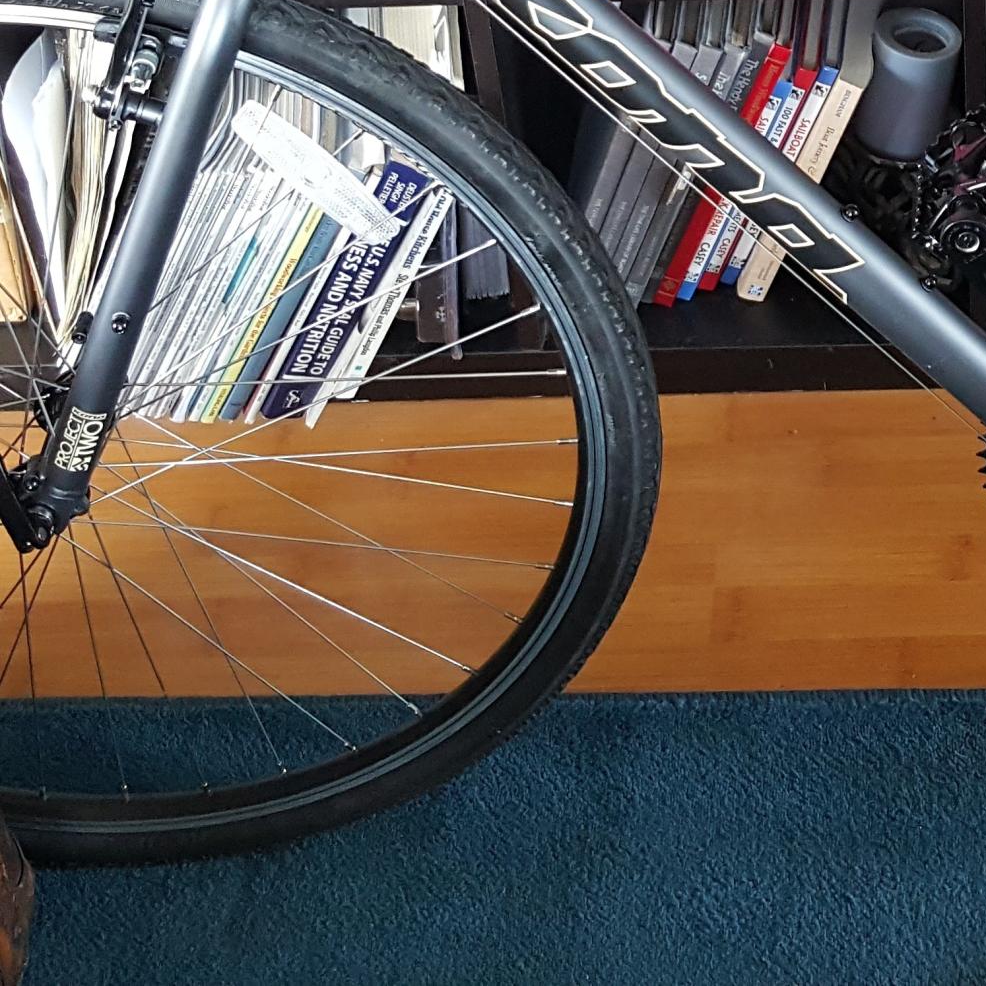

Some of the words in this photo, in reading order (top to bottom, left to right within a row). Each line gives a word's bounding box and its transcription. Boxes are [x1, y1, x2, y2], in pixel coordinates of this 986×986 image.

[773, 119, 786, 137] FAST
[780, 105, 793, 121] 100
[785, 116, 810, 158] SAILBOAT
[377, 171, 399, 205] PELLETIER
[388, 180, 405, 203] SINGH
[362, 244, 384, 270] U.S.
[403, 233, 428, 270] Kitchens
[692, 240, 711, 267] CASEY
[714, 236, 731, 259] CASEY
[324, 269, 353, 305] AND
[347, 266, 374, 301] NAVY
[382, 291, 400, 317] Thomas
[290, 302, 338, 375] NUTRITION
[315, 324, 345, 363] GUIDE
[308, 358, 327, 378] TO
[54, 412, 82, 469] PROJECT
[74, 422, 102, 455] TWO
